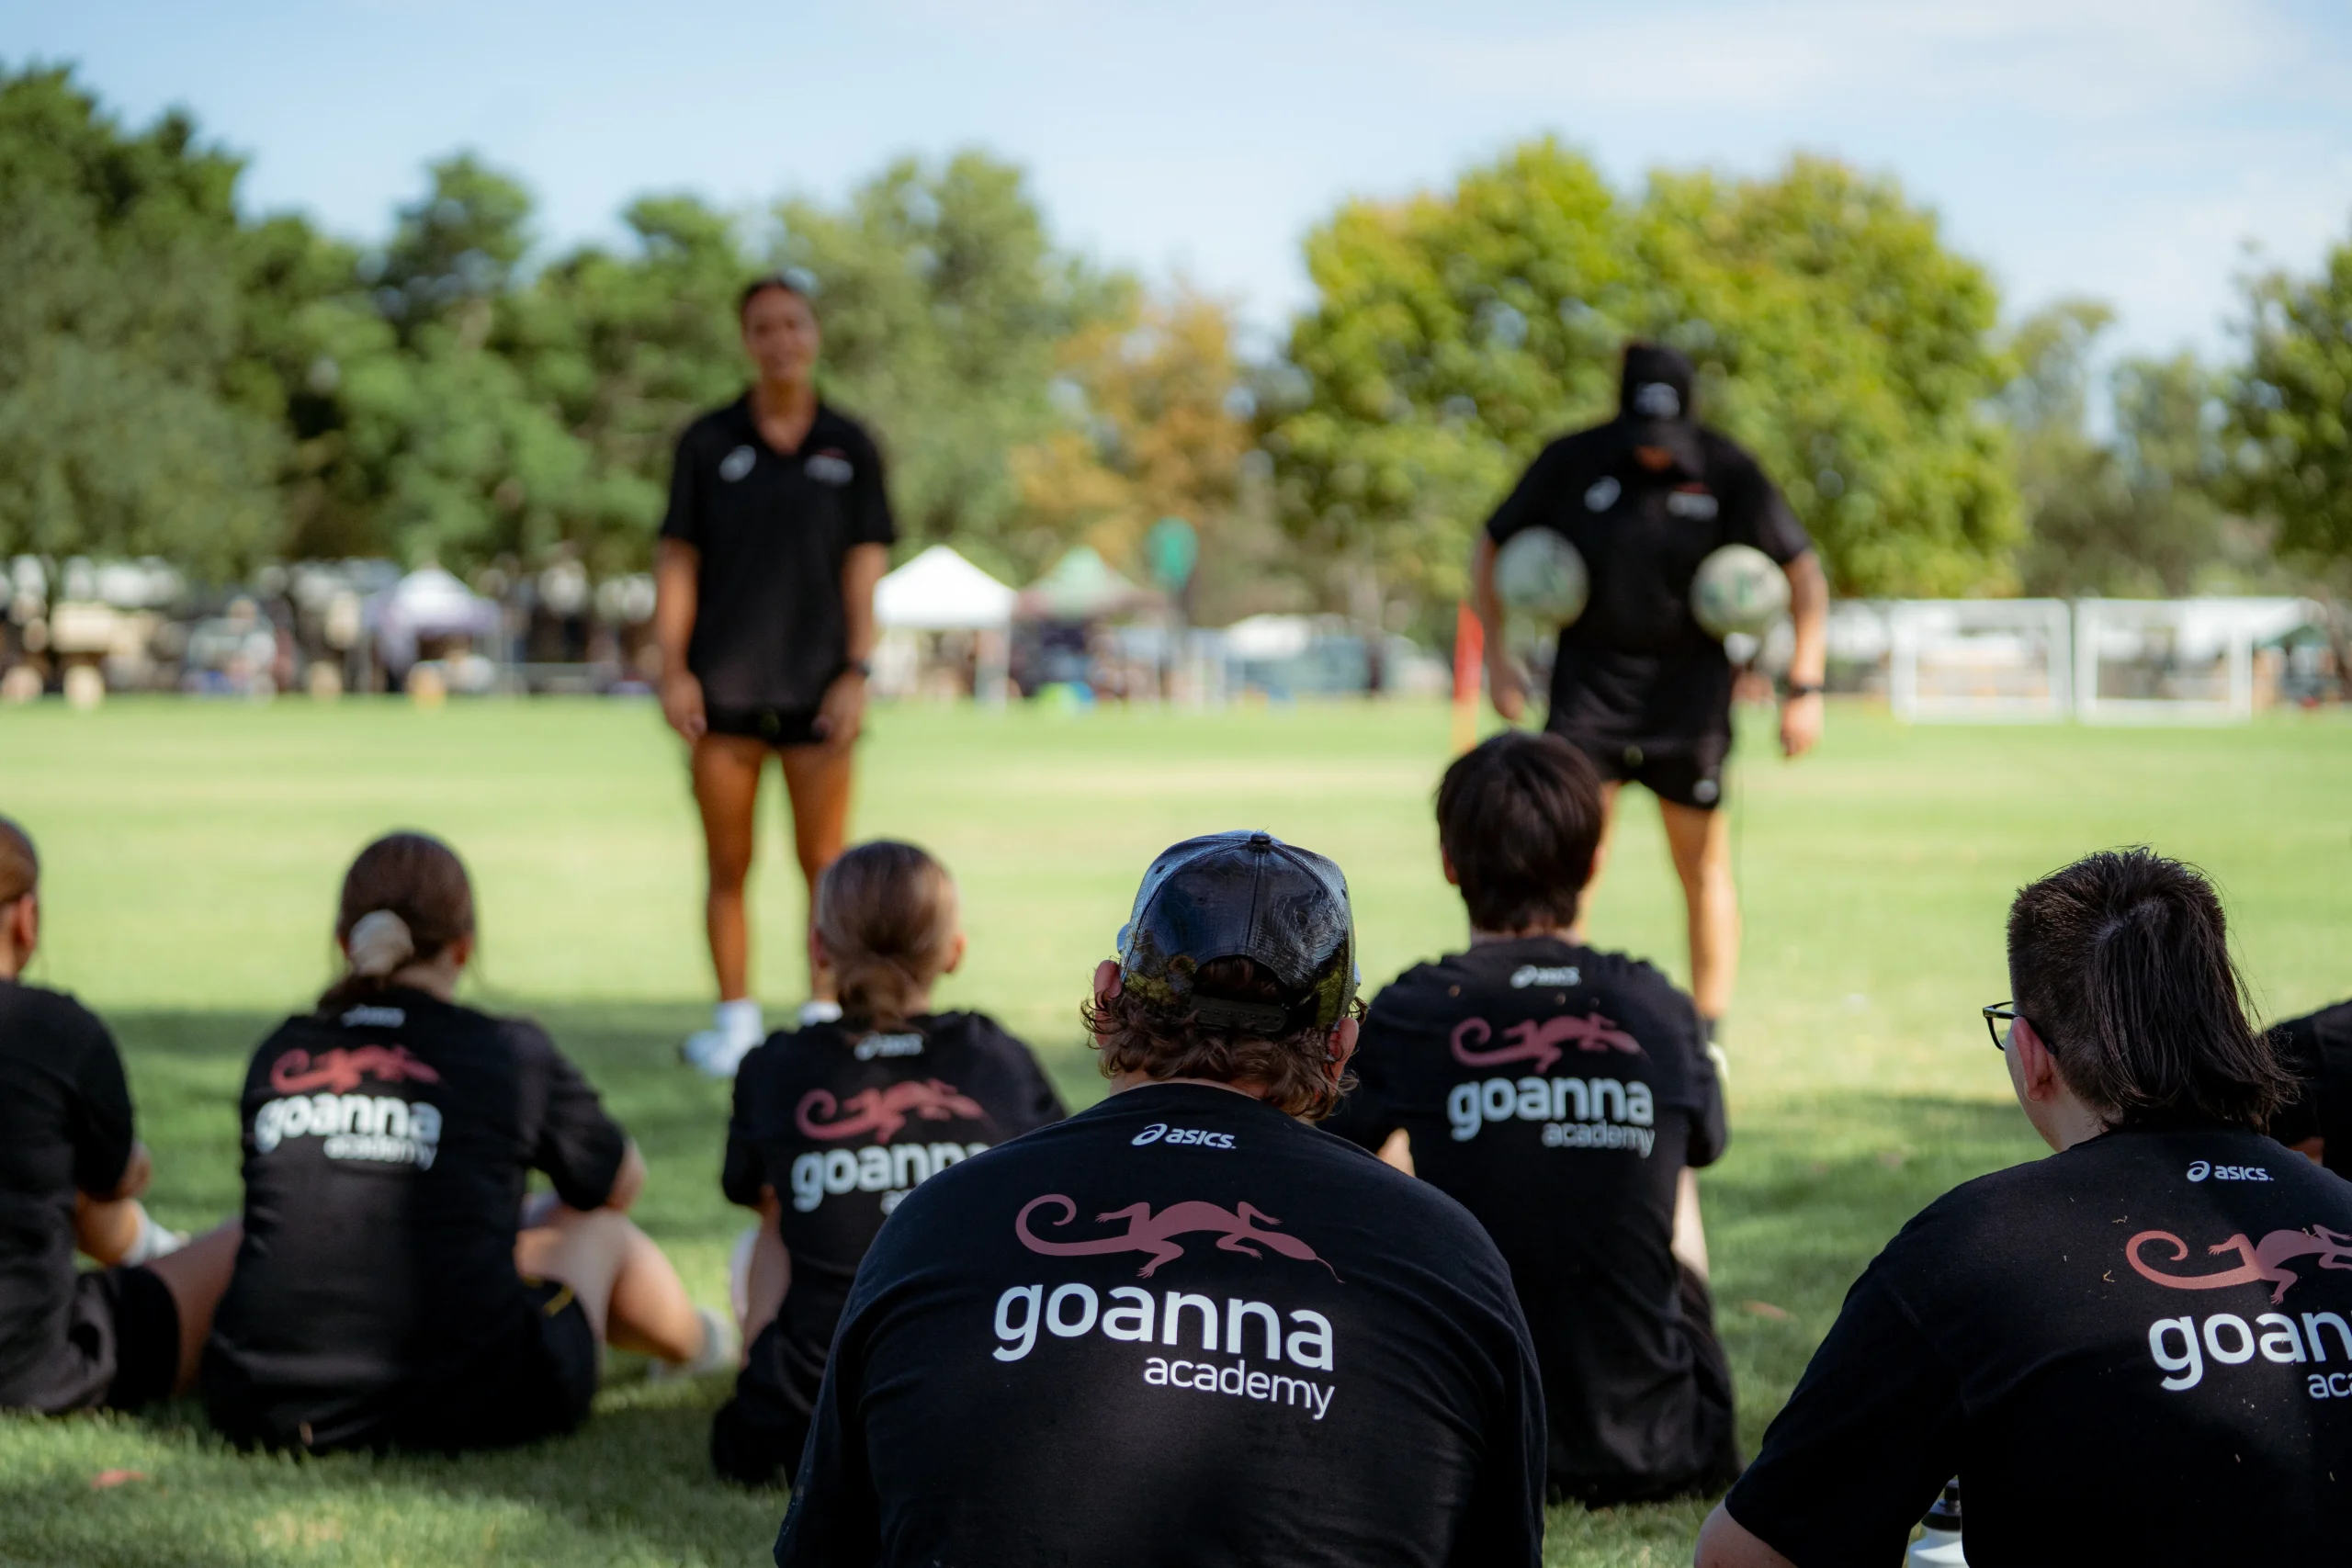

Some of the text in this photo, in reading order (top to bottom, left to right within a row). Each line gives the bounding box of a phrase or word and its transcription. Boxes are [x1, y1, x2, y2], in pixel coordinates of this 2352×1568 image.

[254, 1092, 442, 1153] goanna
[1448, 1077, 1654, 1141] goanna
[1543, 1120, 1656, 1158] academy
[792, 1143, 991, 1211] goann
[992, 1283, 1334, 1371] goanna
[2148, 1313, 2352, 1392] goan
[1144, 1357, 1335, 1420] academy
